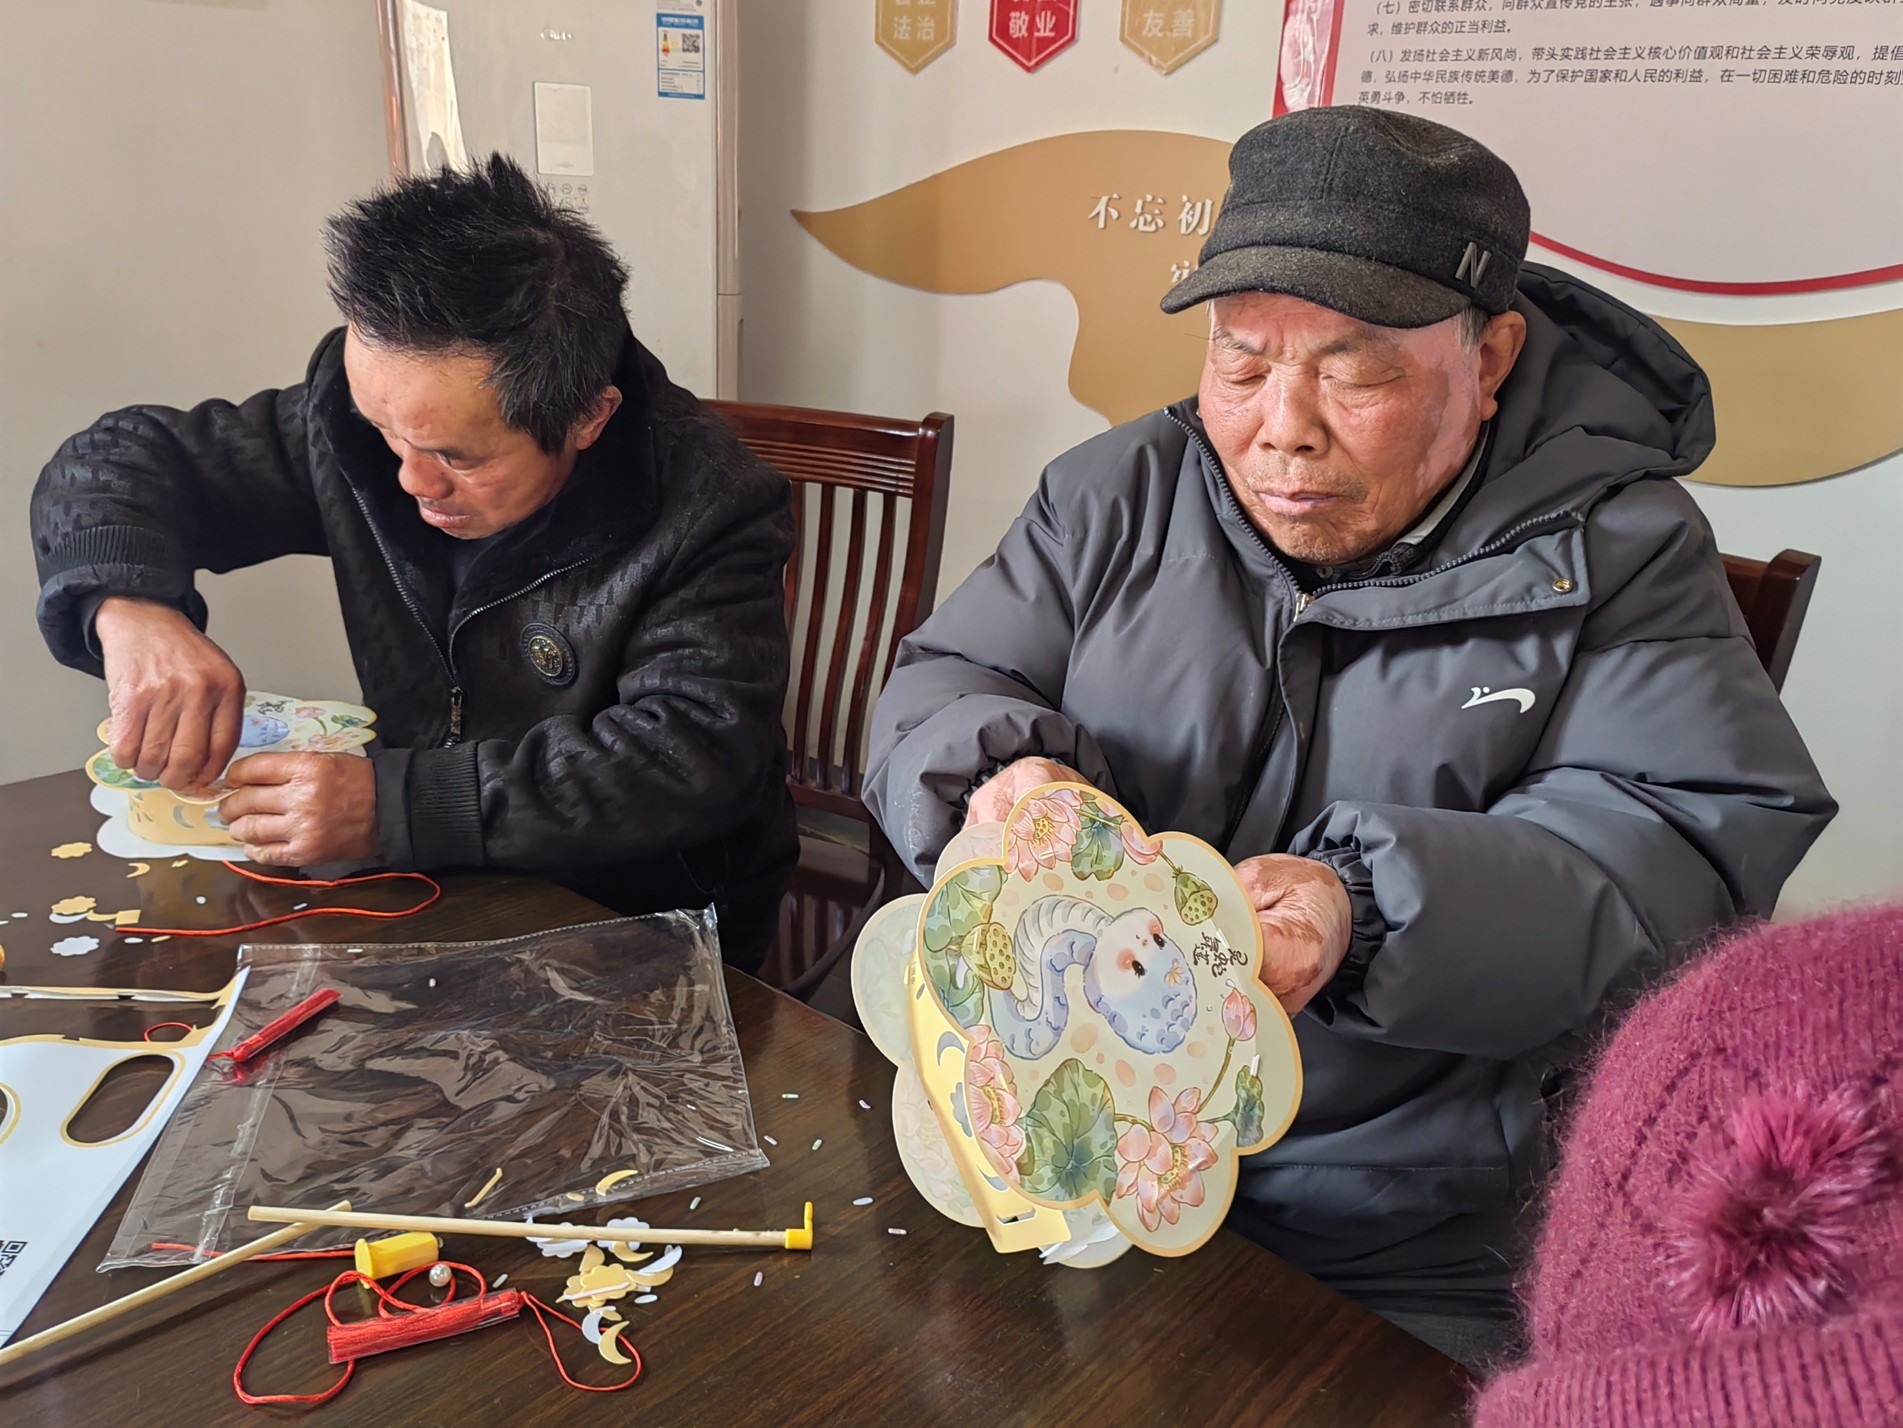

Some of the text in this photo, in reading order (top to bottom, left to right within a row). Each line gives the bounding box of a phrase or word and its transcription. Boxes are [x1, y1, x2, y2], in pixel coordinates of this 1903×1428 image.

[893, 16, 936, 41] 法治
[1009, 11, 1056, 39] 敬业
[1142, 10, 1197, 38] 友善
[1367, 19, 1512, 37] 求，维护群众的正当利益。
[1361, 69, 1903, 86] 德，弘扬中华民族传统美德，为了保护国家和人民的利益，在一切困难和危险的时刻
[1359, 91, 1474, 105] 英勇斗争，不怕牺牲。
[1088, 193, 1213, 236] 不忘初
[1455, 241, 1492, 288] N
